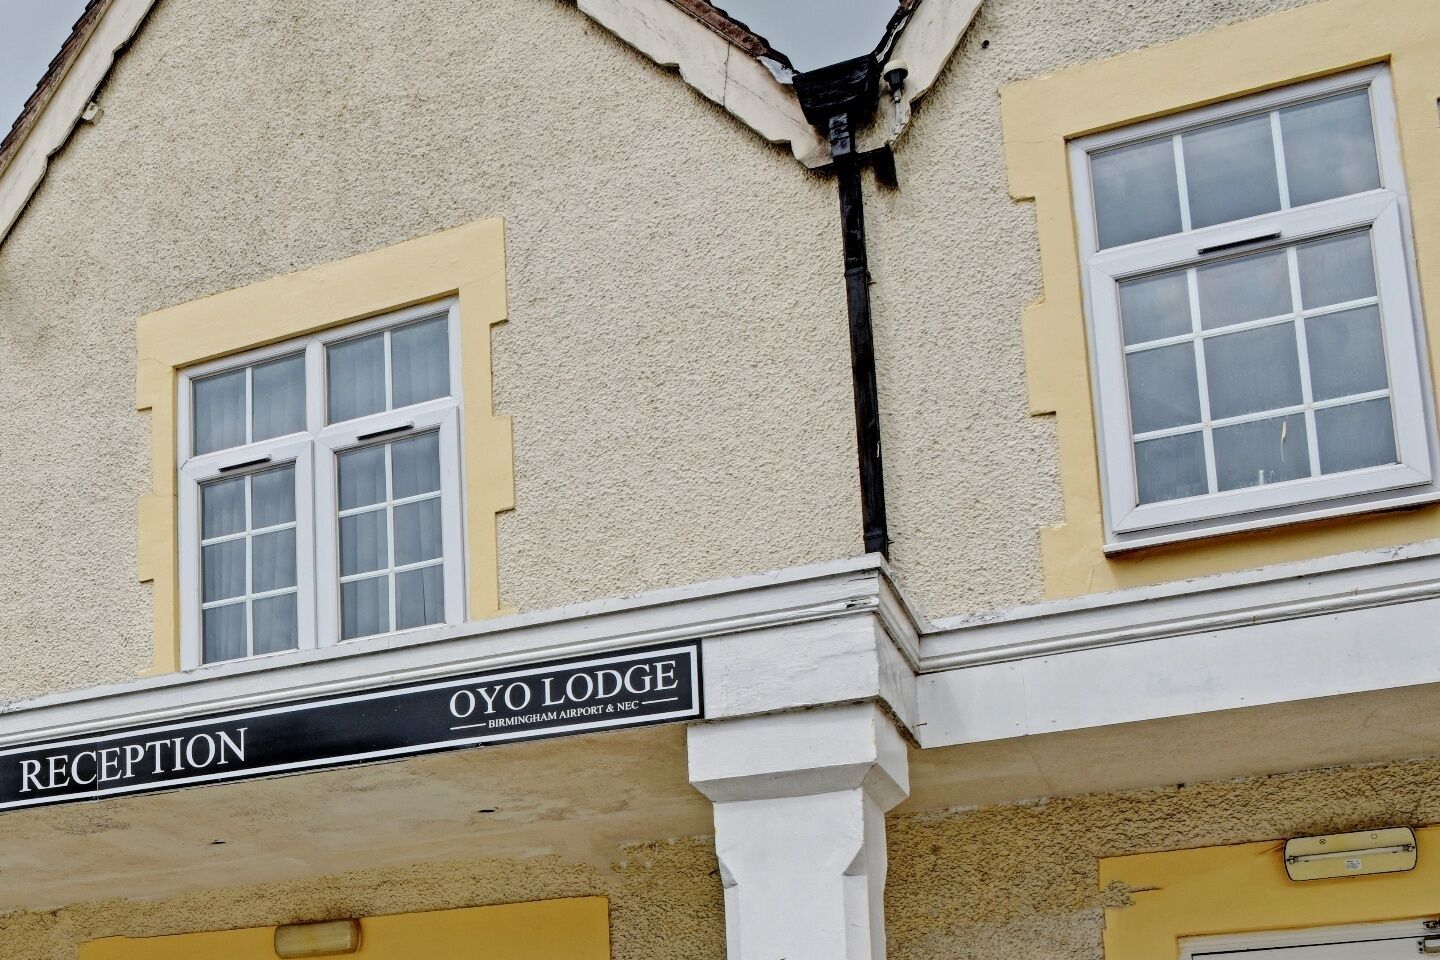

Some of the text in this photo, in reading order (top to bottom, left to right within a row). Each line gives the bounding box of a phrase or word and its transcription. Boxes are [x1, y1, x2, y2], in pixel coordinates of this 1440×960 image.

[449, 660, 679, 718] OYO LODGE
[488, 700, 639, 729] BIRMINGHAM AIRPORT & NEC
[18, 727, 249, 793] RECEPTION
